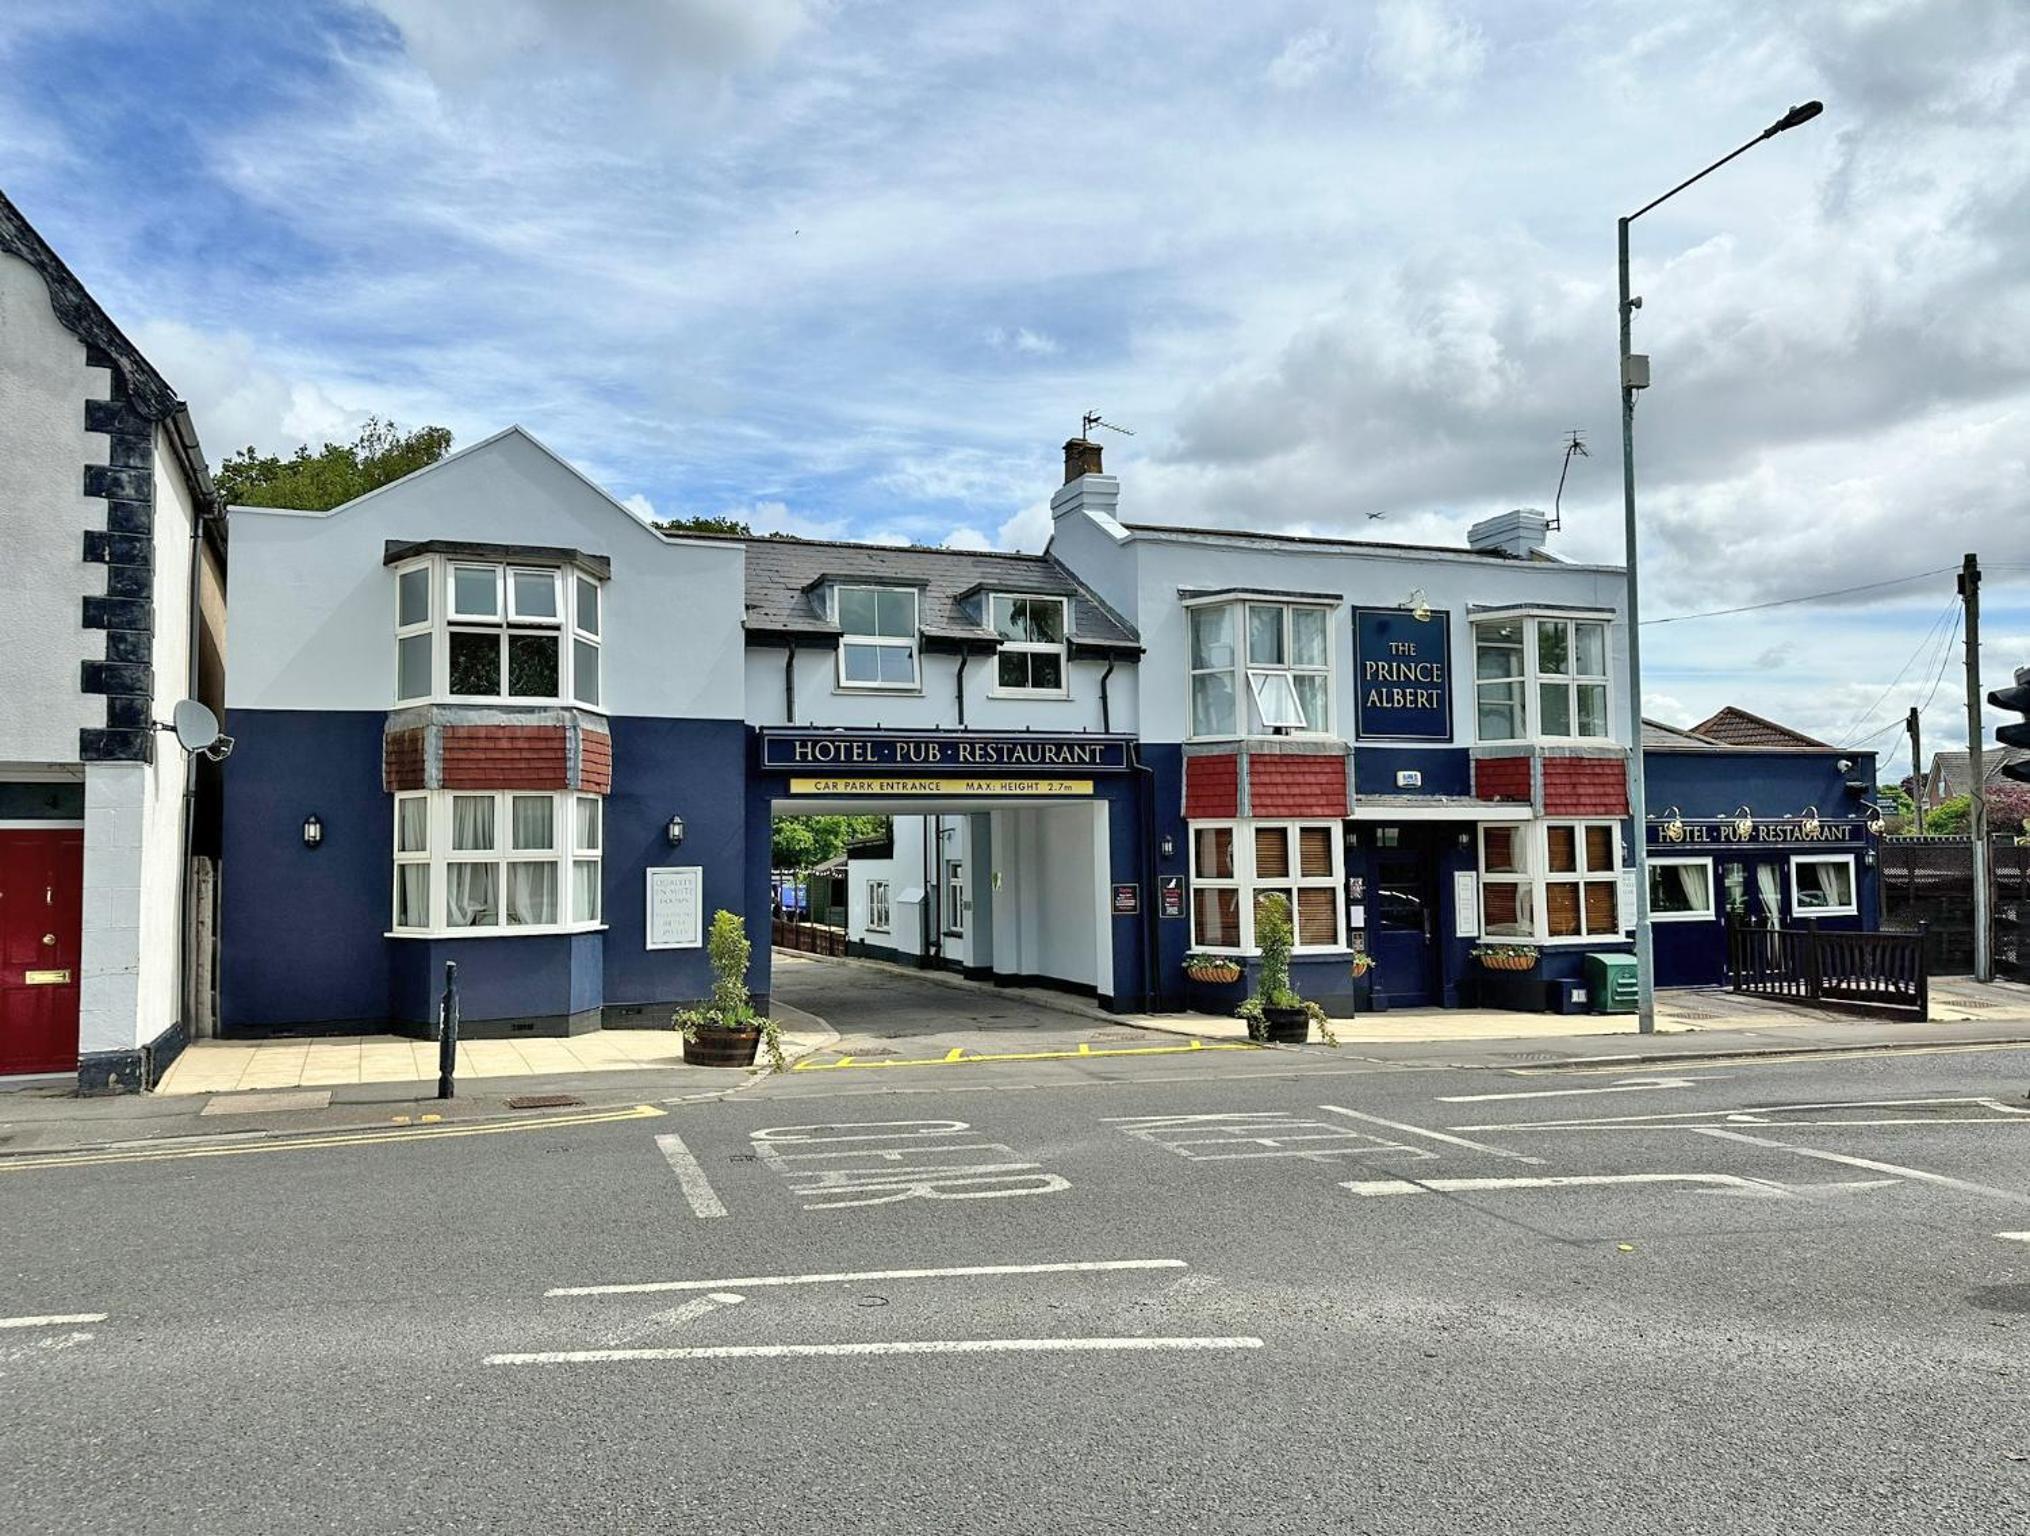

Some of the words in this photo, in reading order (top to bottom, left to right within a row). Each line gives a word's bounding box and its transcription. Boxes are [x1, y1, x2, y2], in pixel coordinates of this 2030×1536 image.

[1389, 642, 1417, 656] THE
[1366, 661, 1442, 682] PRINCE
[1367, 688, 1441, 708] ALBERT
[794, 741, 877, 762] HOTEL
[895, 742, 941, 762] PUB
[958, 742, 1105, 764] RESTAURANT
[814, 781, 839, 792] CAR
[844, 781, 874, 792] PARK
[879, 781, 942, 792] ENTRANCE
[1000, 781, 1040, 792] HEIGHT
[1047, 781, 1074, 792] 2.7m
[1098, 1111, 1440, 1162] KEEP
[749, 1118, 1072, 1211] CLEAR
